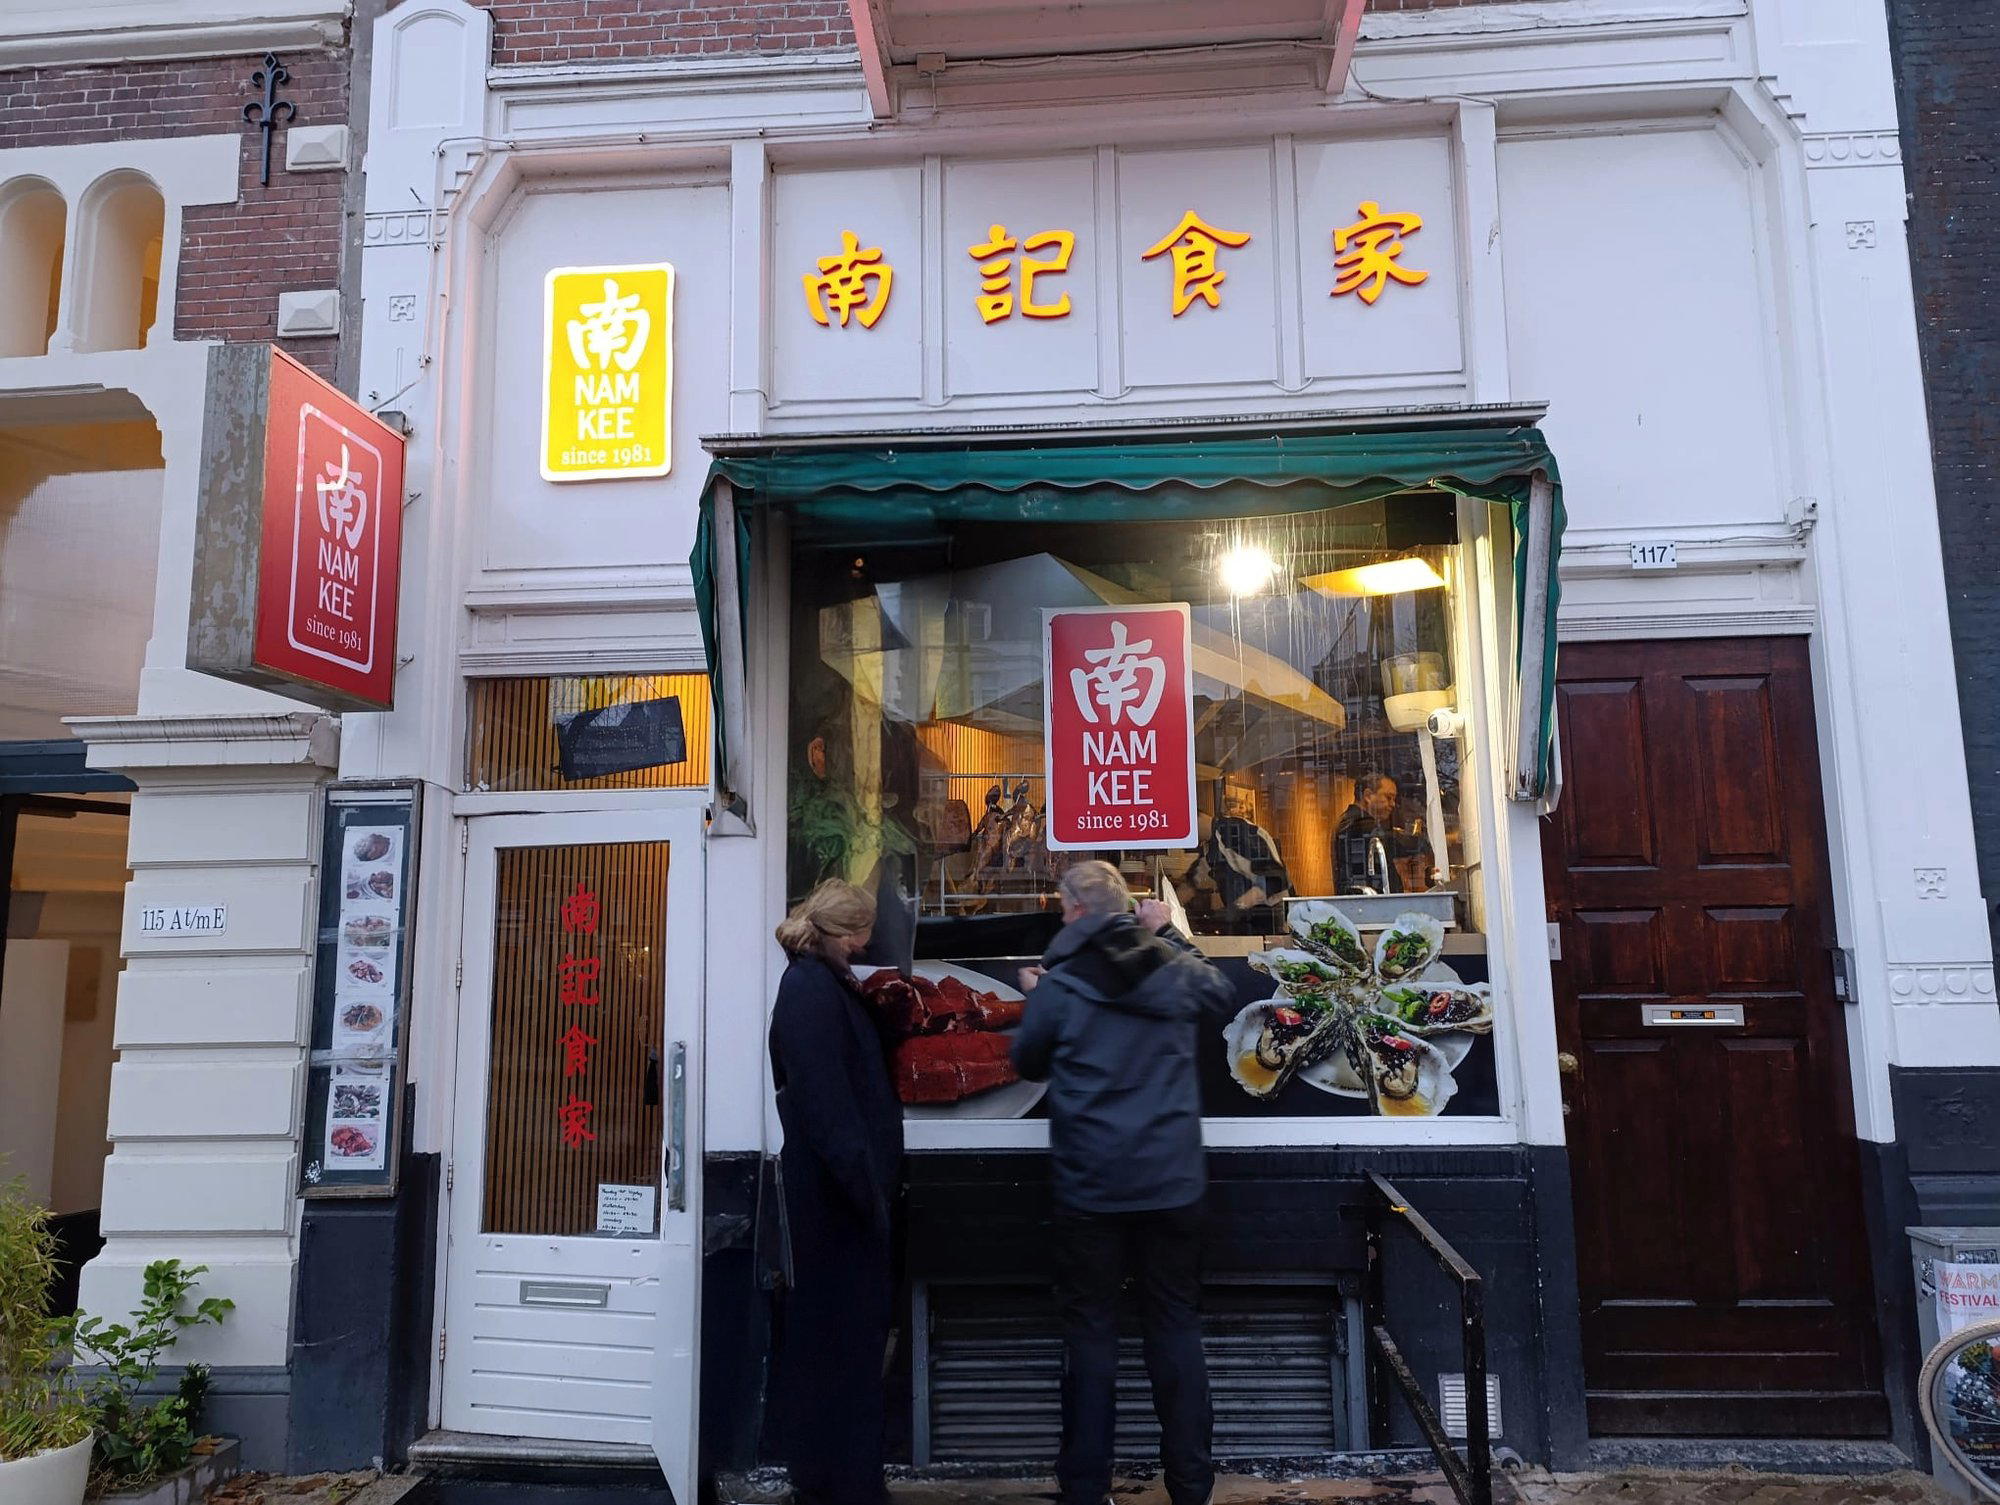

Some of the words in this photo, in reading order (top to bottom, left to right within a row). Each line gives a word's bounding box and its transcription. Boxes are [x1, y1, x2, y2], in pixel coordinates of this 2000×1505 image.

[803, 200, 1428, 330] 南記食家
[566, 278, 651, 372] 南
[574, 372, 640, 406] NAM
[577, 407, 635, 441] KEE
[561, 446, 607, 466] since
[612, 445, 652, 466] 1981
[316, 443, 368, 550] 南
[318, 537, 359, 587] NAM
[1638, 546, 1667, 563] 117
[318, 576, 354, 622] KEE
[306, 614, 336, 642] since
[339, 628, 362, 651] 1981
[1069, 620, 1167, 728] 南
[1082, 729, 1157, 766] NAM
[1088, 769, 1154, 806] KEE
[1077, 810, 1123, 830] since
[1128, 810, 1169, 832] 1981
[141, 909, 165, 931] 115
[556, 882, 600, 1149] 南記食家
[1939, 1269, 2000, 1289] WARM
[1940, 1290, 1999, 1307] FESTIVAL
